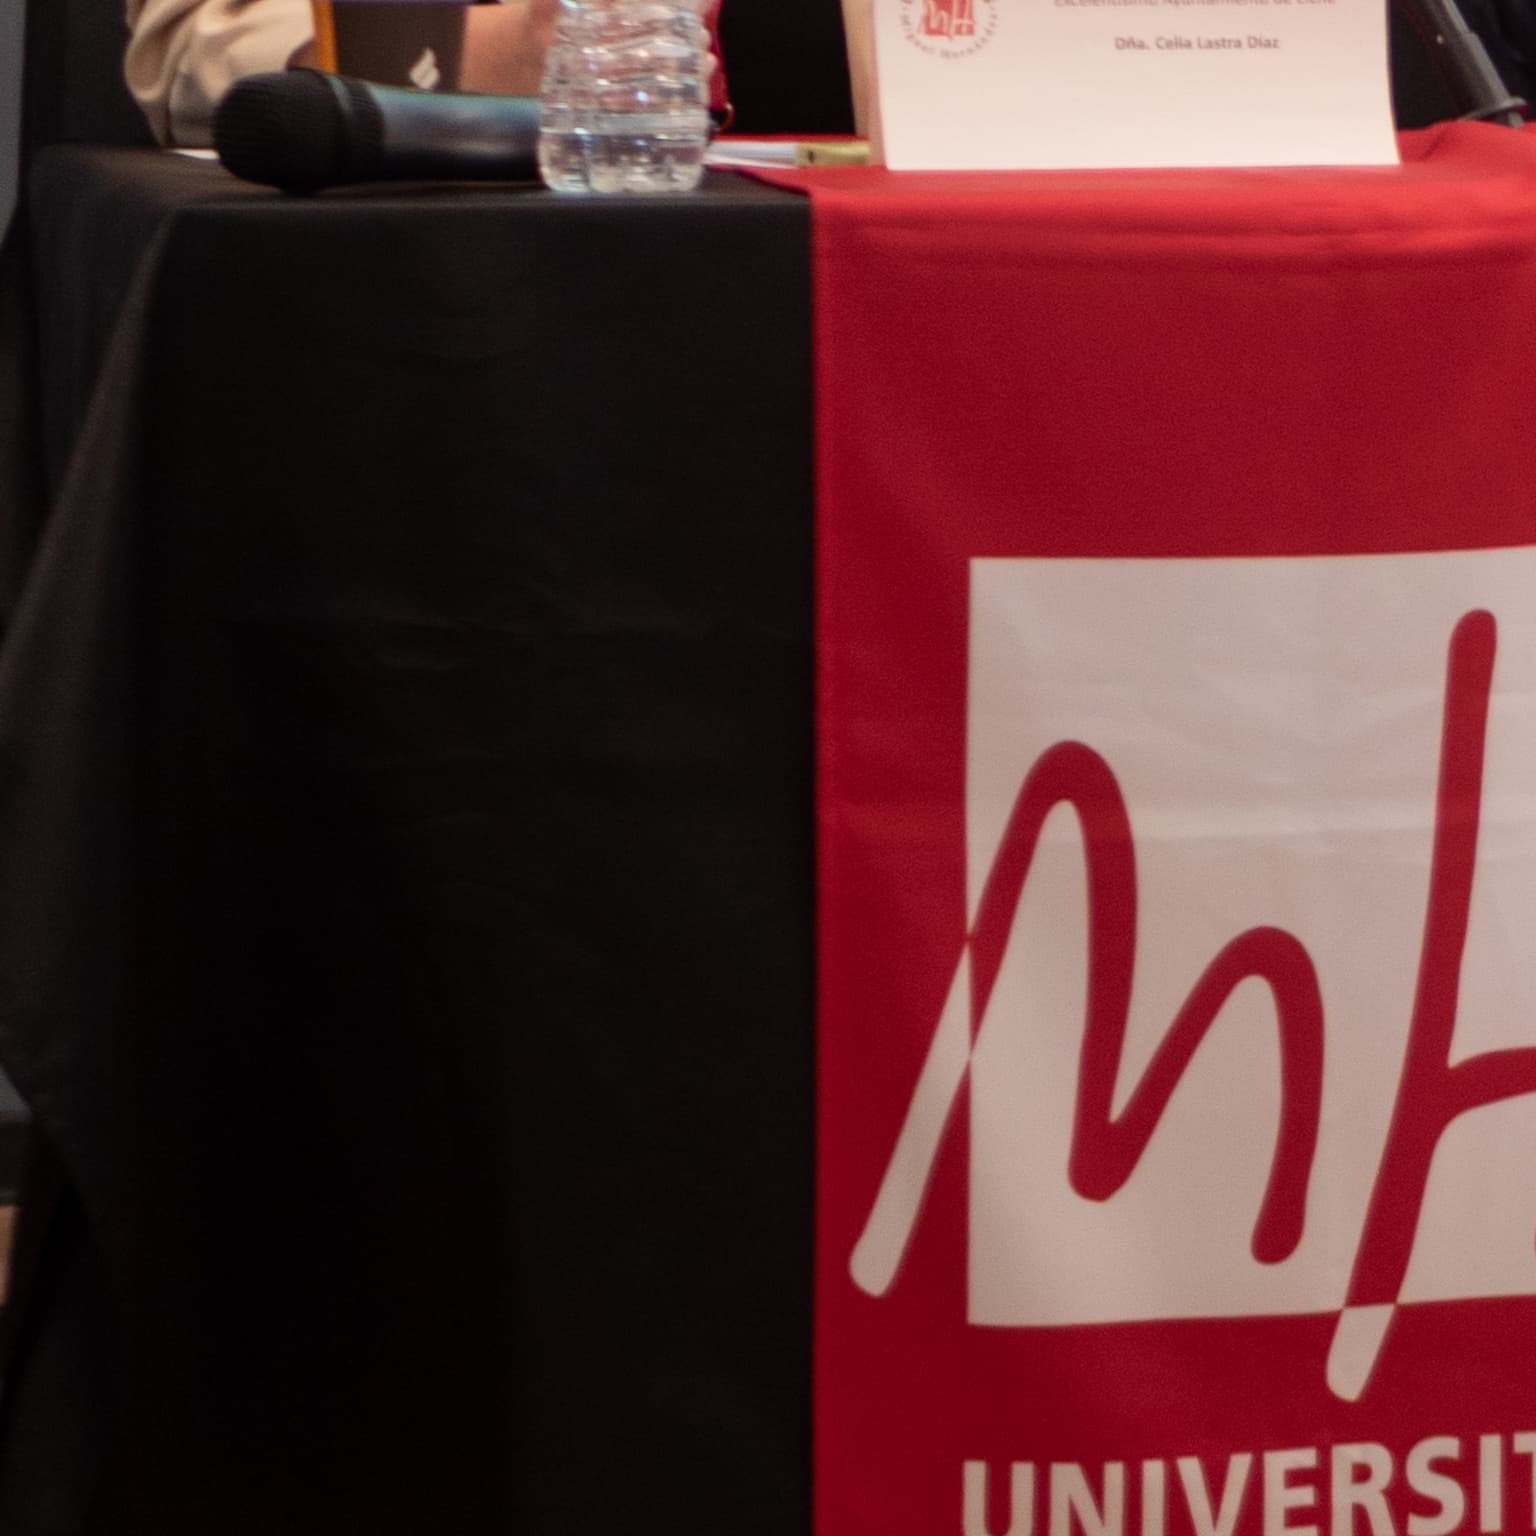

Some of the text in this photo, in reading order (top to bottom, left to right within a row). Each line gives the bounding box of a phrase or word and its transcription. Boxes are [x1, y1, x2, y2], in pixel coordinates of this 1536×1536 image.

[1114, 35, 1150, 50] Dña.
[1155, 35, 1192, 50] Celia
[1197, 36, 1242, 50] Lastra
